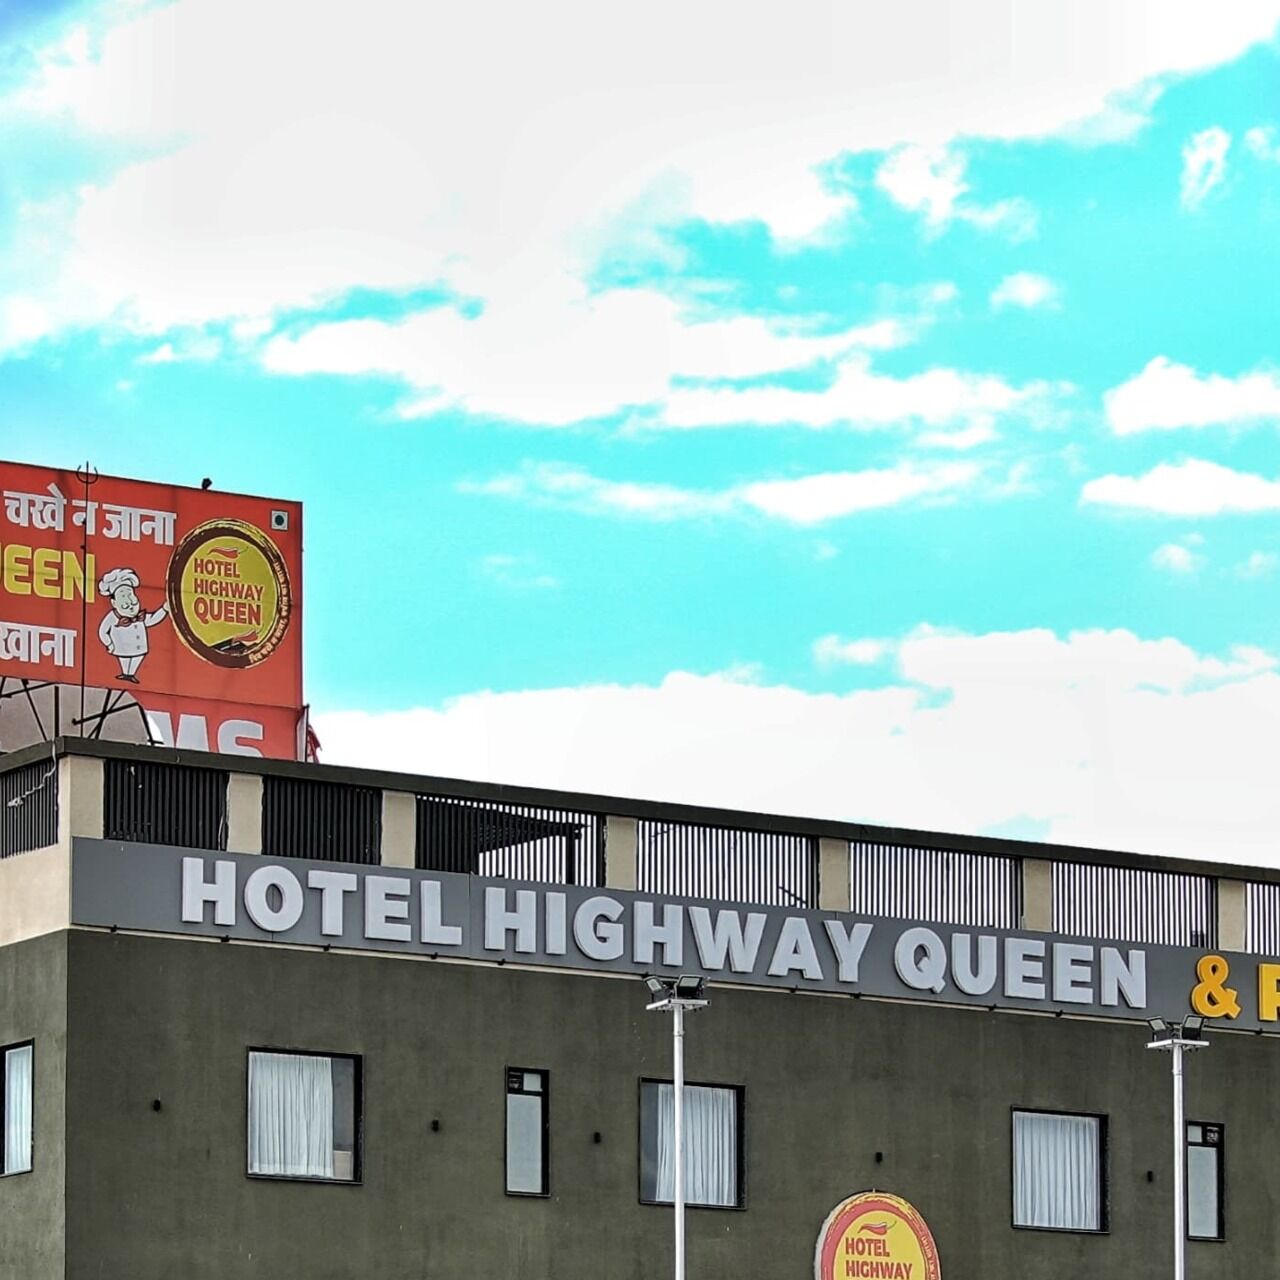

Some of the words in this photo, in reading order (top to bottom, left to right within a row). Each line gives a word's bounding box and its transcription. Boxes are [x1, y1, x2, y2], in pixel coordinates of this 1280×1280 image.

[3, 482, 67, 532] चखे
[72, 500, 98, 536] न
[102, 503, 177, 546] जाना
[194, 558, 240, 578] HOTEL
[194, 578, 264, 601] HIGHWAY
[194, 597, 261, 625] QUEEN
[182, 857, 463, 946] HOTEL
[484, 887, 874, 983] HIGHWAY
[894, 926, 1147, 1009] QUEEN
[1190, 954, 1242, 1020] &
[845, 1237, 890, 1257] HOTEL
[846, 1260, 912, 1280] HIGHWAY
